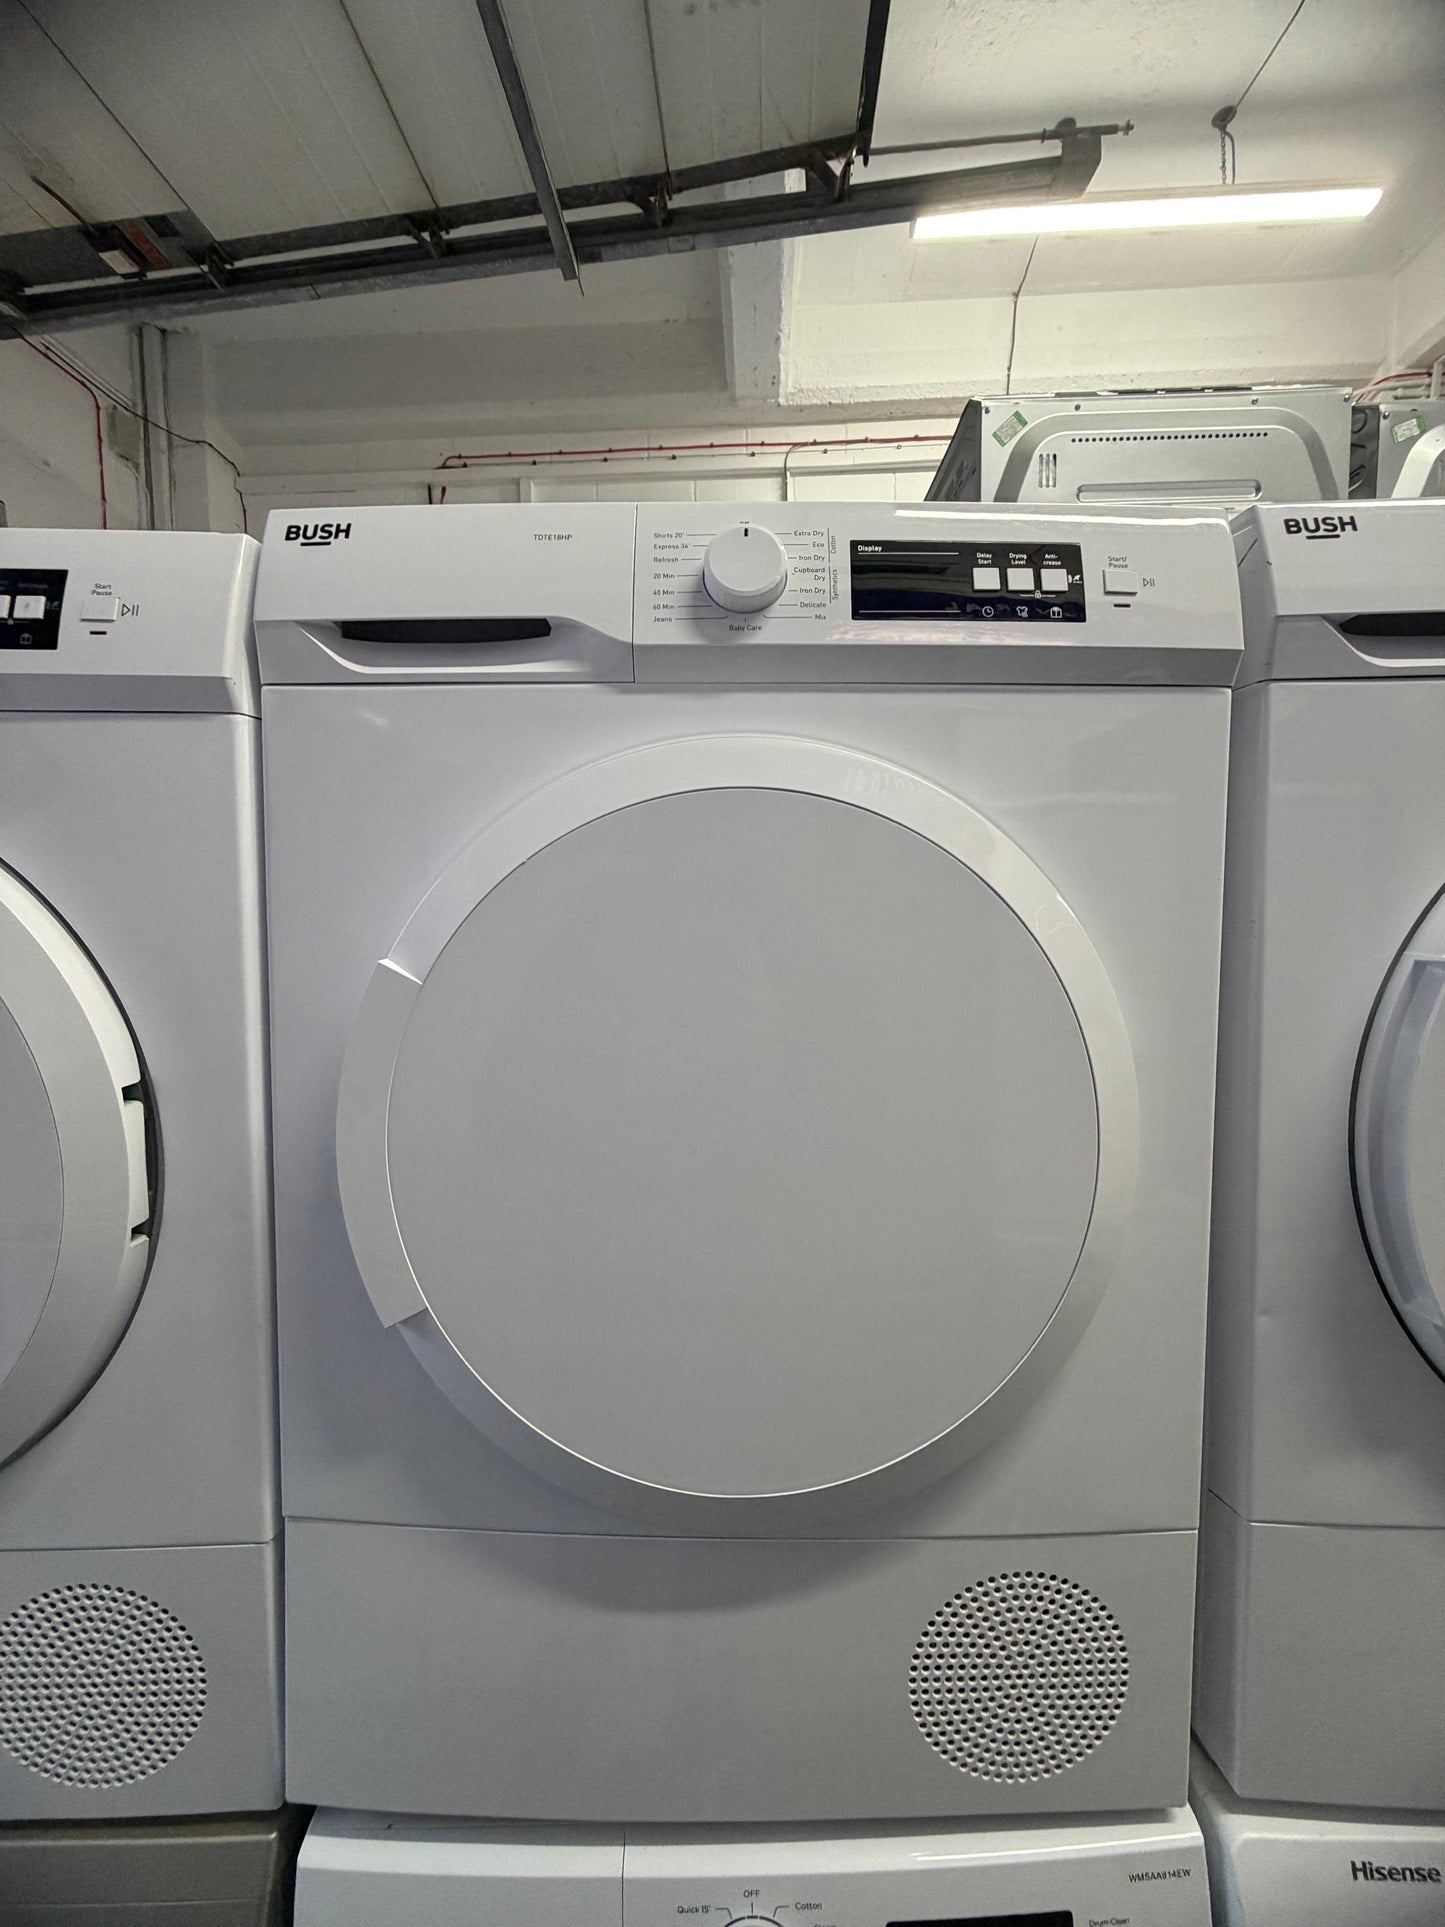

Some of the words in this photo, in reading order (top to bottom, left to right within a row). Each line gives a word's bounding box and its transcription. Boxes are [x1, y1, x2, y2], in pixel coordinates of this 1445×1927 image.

[1283, 515, 1358, 535] BUSH
[284, 522, 352, 542] BUSH
[812, 530, 825, 538] Dry
[533, 533, 573, 541] TDTE18HP
[857, 544, 883, 553] Display
[653, 556, 679, 564] Refresh
[798, 554, 812, 562] Iron
[813, 554, 826, 563] Dry
[1009, 552, 1028, 561] Drying
[793, 566, 826, 574] Cupboard
[813, 575, 826, 583] Dry
[831, 568, 840, 601] Synthetics
[653, 589, 662, 597] 40
[814, 587, 827, 595] Dry
[799, 601, 827, 609] Delicate
[653, 615, 673, 623] Jeans
[728, 624, 746, 632] Baby
[746, 624, 763, 632] Care
[1350, 1860, 1442, 1884] Hisense
[743, 1889, 760, 1898] OFF
[677, 1905, 700, 1914] Quick
[794, 1902, 823, 1911] Cotton
